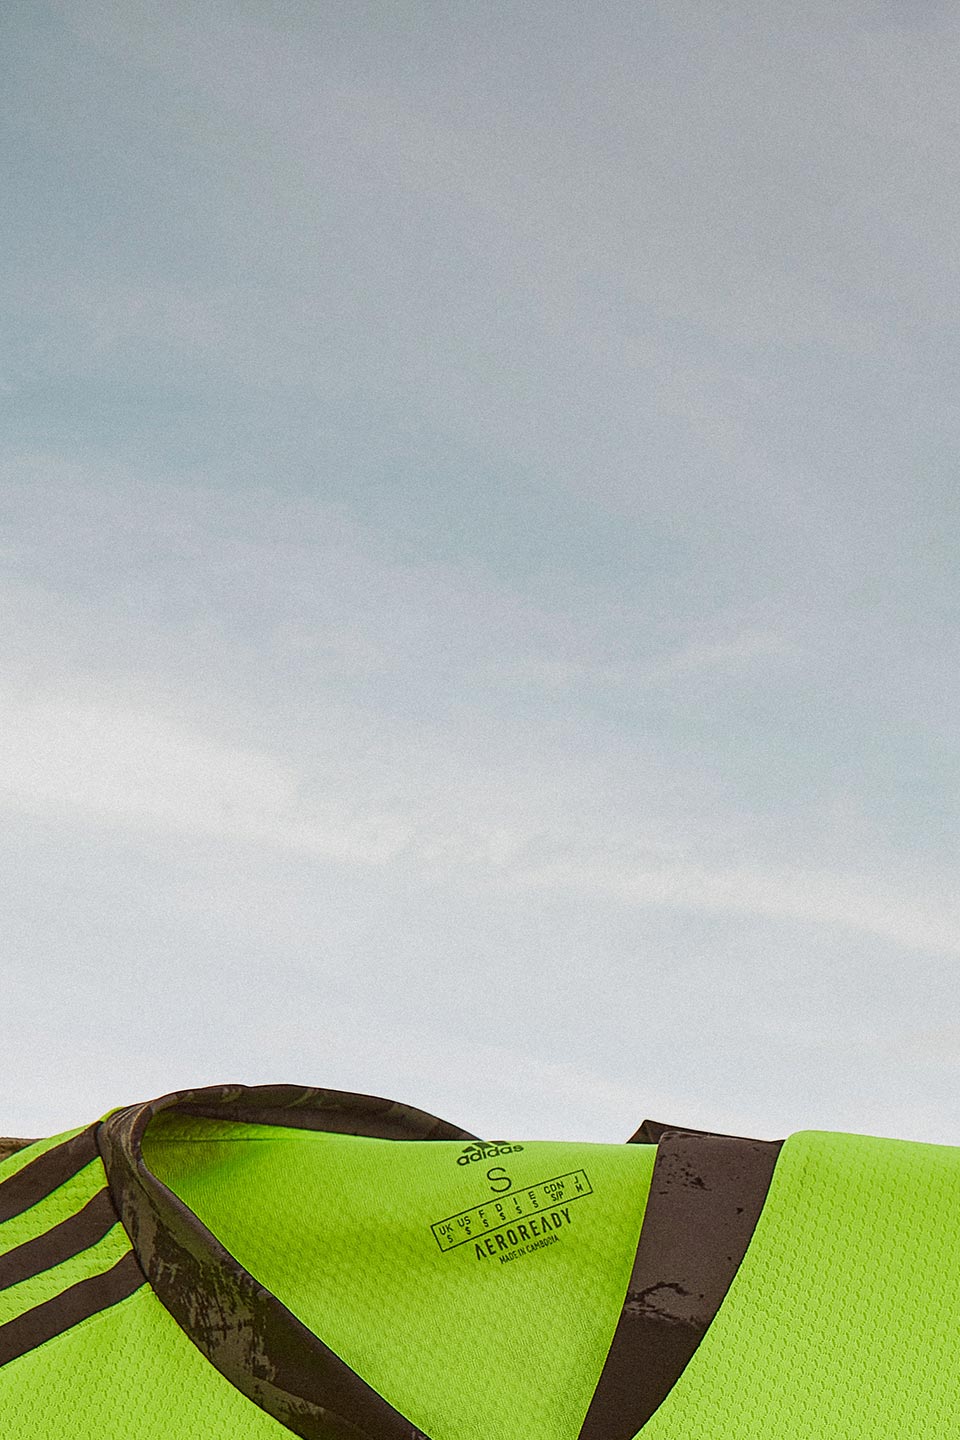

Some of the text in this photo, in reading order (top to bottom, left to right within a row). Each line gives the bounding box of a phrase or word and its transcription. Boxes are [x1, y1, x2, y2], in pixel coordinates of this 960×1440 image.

[457, 1144, 524, 1166] adidas
[486, 1167, 512, 1192] S
[438, 1224, 454, 1236] UK
[457, 1215, 471, 1228] US
[478, 1209, 486, 1219] F
[495, 1203, 503, 1212] D
[528, 1191, 536, 1200] E
[543, 1181, 565, 1195] CDN
[573, 1175, 579, 1184] J
[446, 1184, 584, 1244] S S S S S S S/P M
[474, 1207, 572, 1261] AEROREADY
[499, 1250, 518, 1264] MADE
[517, 1247, 526, 1256] IN
